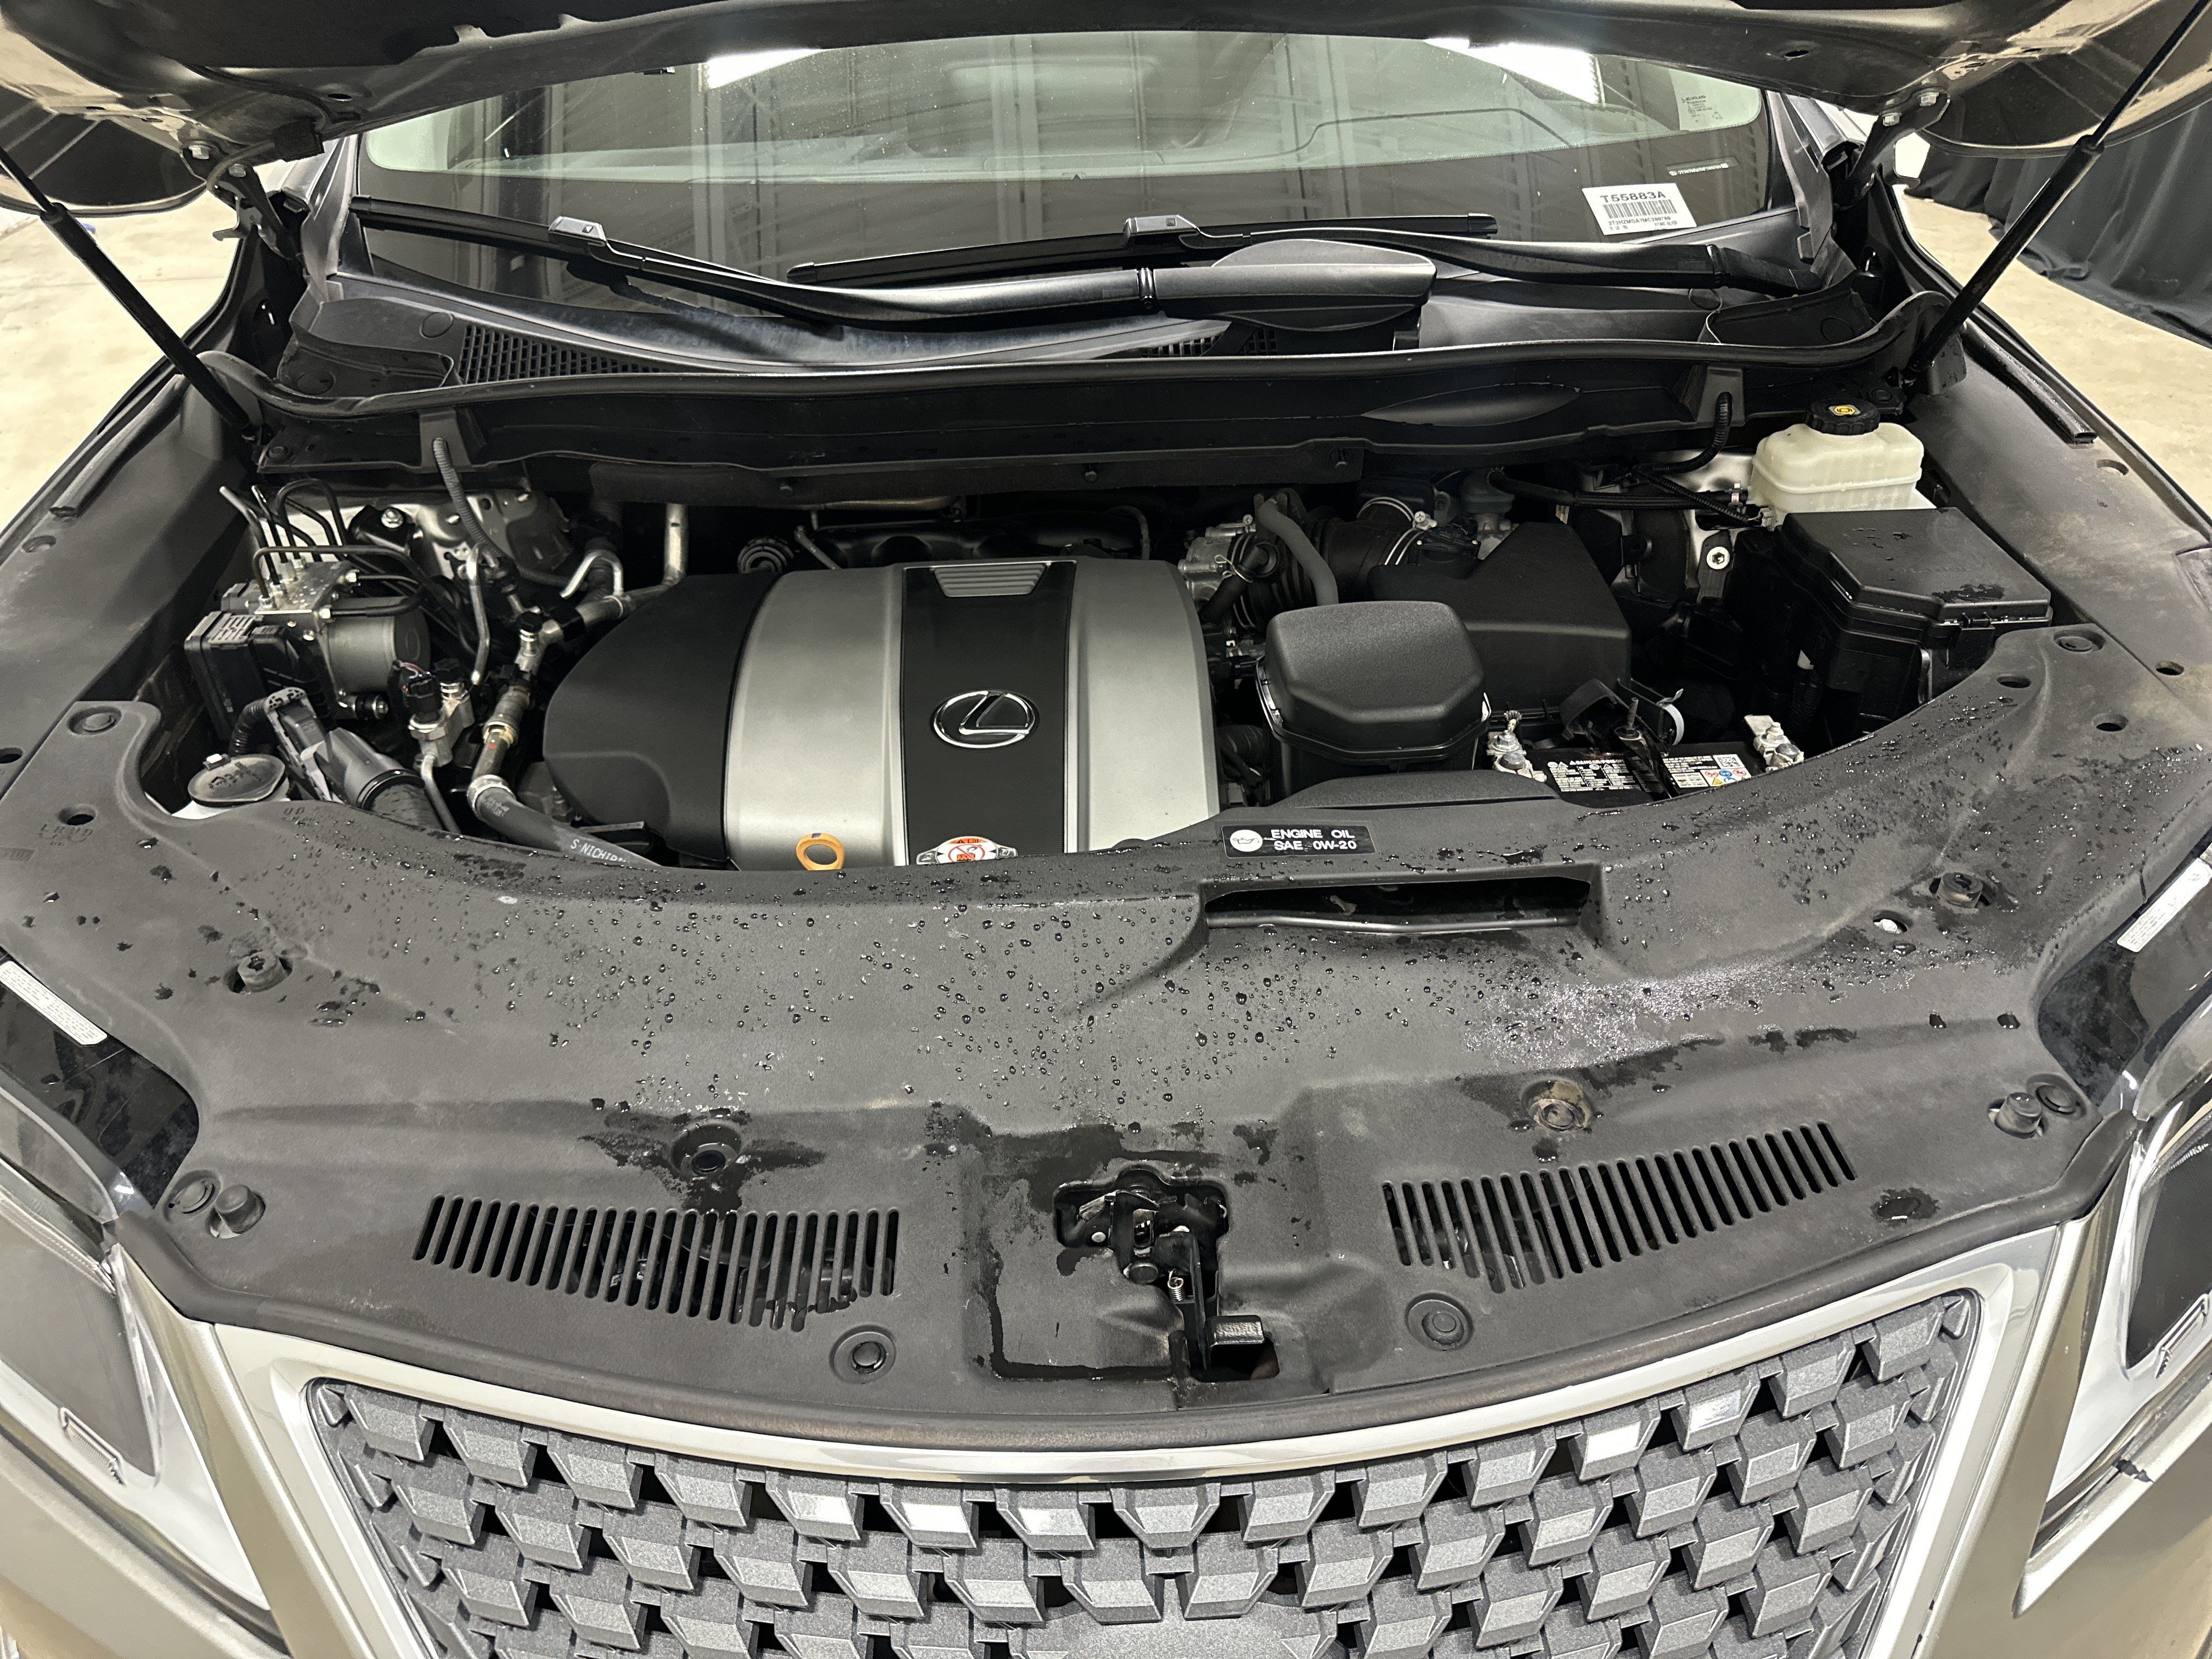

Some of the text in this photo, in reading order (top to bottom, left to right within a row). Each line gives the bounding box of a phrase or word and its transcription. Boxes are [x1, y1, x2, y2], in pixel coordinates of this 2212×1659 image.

[1600, 191, 1666, 203] T55883A
[1271, 829, 1355, 839] ENGINE OIL
[1274, 840, 1357, 850] SAE 0W-20
